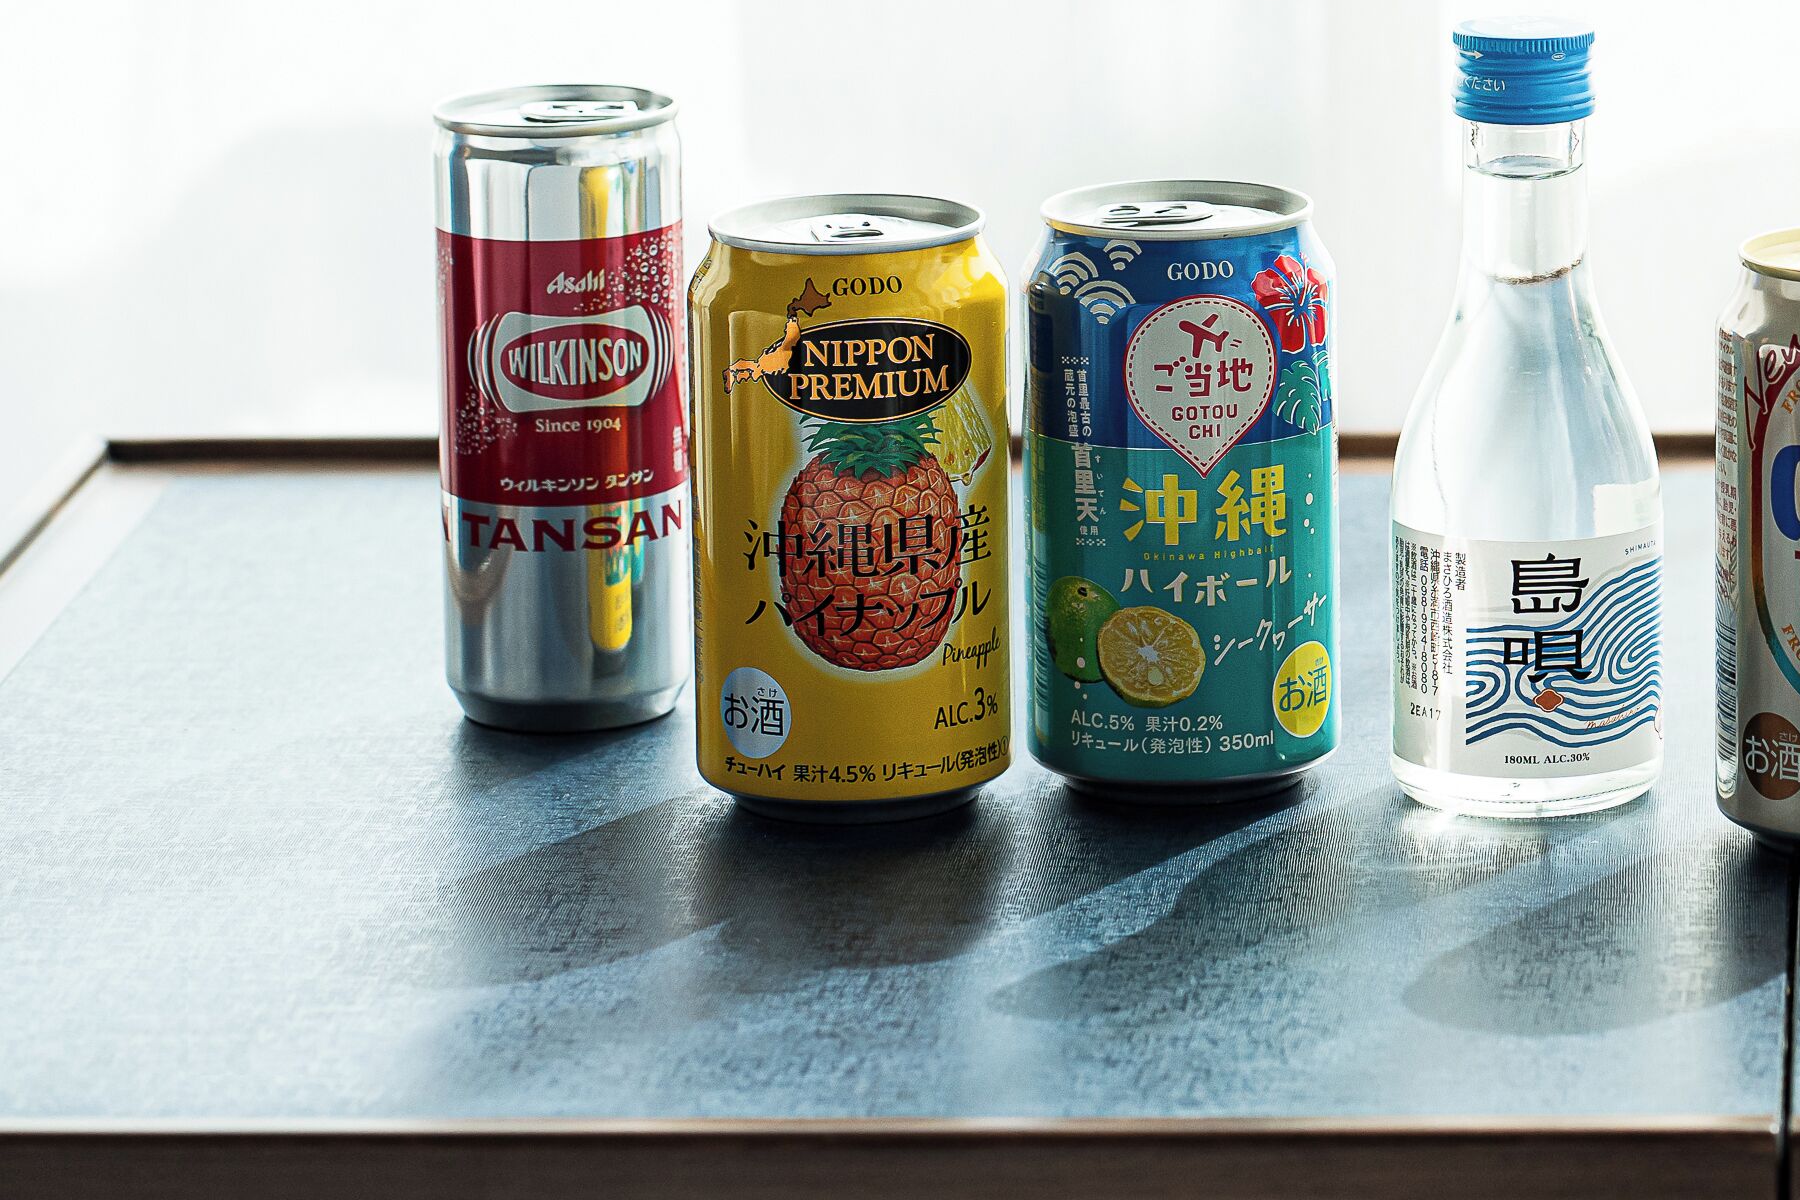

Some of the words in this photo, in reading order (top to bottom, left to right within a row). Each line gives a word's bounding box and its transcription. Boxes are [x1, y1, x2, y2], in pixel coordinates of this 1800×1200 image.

[546, 268, 606, 295] Asahi
[832, 275, 902, 297] GODO
[1167, 260, 1234, 281] GODO
[508, 338, 642, 386] WILKINSON
[803, 333, 935, 368] NIPPON
[788, 364, 950, 401] PREMIUM
[1153, 356, 1254, 398] ご当地
[535, 418, 580, 433] Since
[586, 417, 622, 434] 1904
[1171, 402, 1238, 422] GOTOU
[1188, 422, 1222, 440] CHI
[500, 477, 600, 492] ウィルキンソン
[604, 469, 654, 489] タンサン
[1071, 442, 1099, 522] 首里天
[1119, 464, 1288, 546] 沖縄
[462, 500, 682, 552] TANSAN
[743, 503, 992, 578] 沖縄県産
[1143, 552, 1205, 561] Okinawa
[1120, 556, 1292, 607] ハイボール
[745, 577, 993, 637] パイナップル
[1503, 552, 1592, 683] 島唄
[942, 625, 1001, 670] Pineapple
[1279, 664, 1328, 713] お酒
[724, 693, 785, 737] お酒
[934, 687, 998, 730] ALC.3%
[1071, 709, 1135, 732] ALC.5%
[1145, 715, 1223, 732] 果汁0.2%
[1219, 730, 1275, 752] 350ml
[1504, 754, 1540, 765] 180ML
[1543, 752, 1590, 764] ALC.30%
[725, 756, 786, 781] チューハイ
[793, 764, 876, 784] 果汁4.5%
